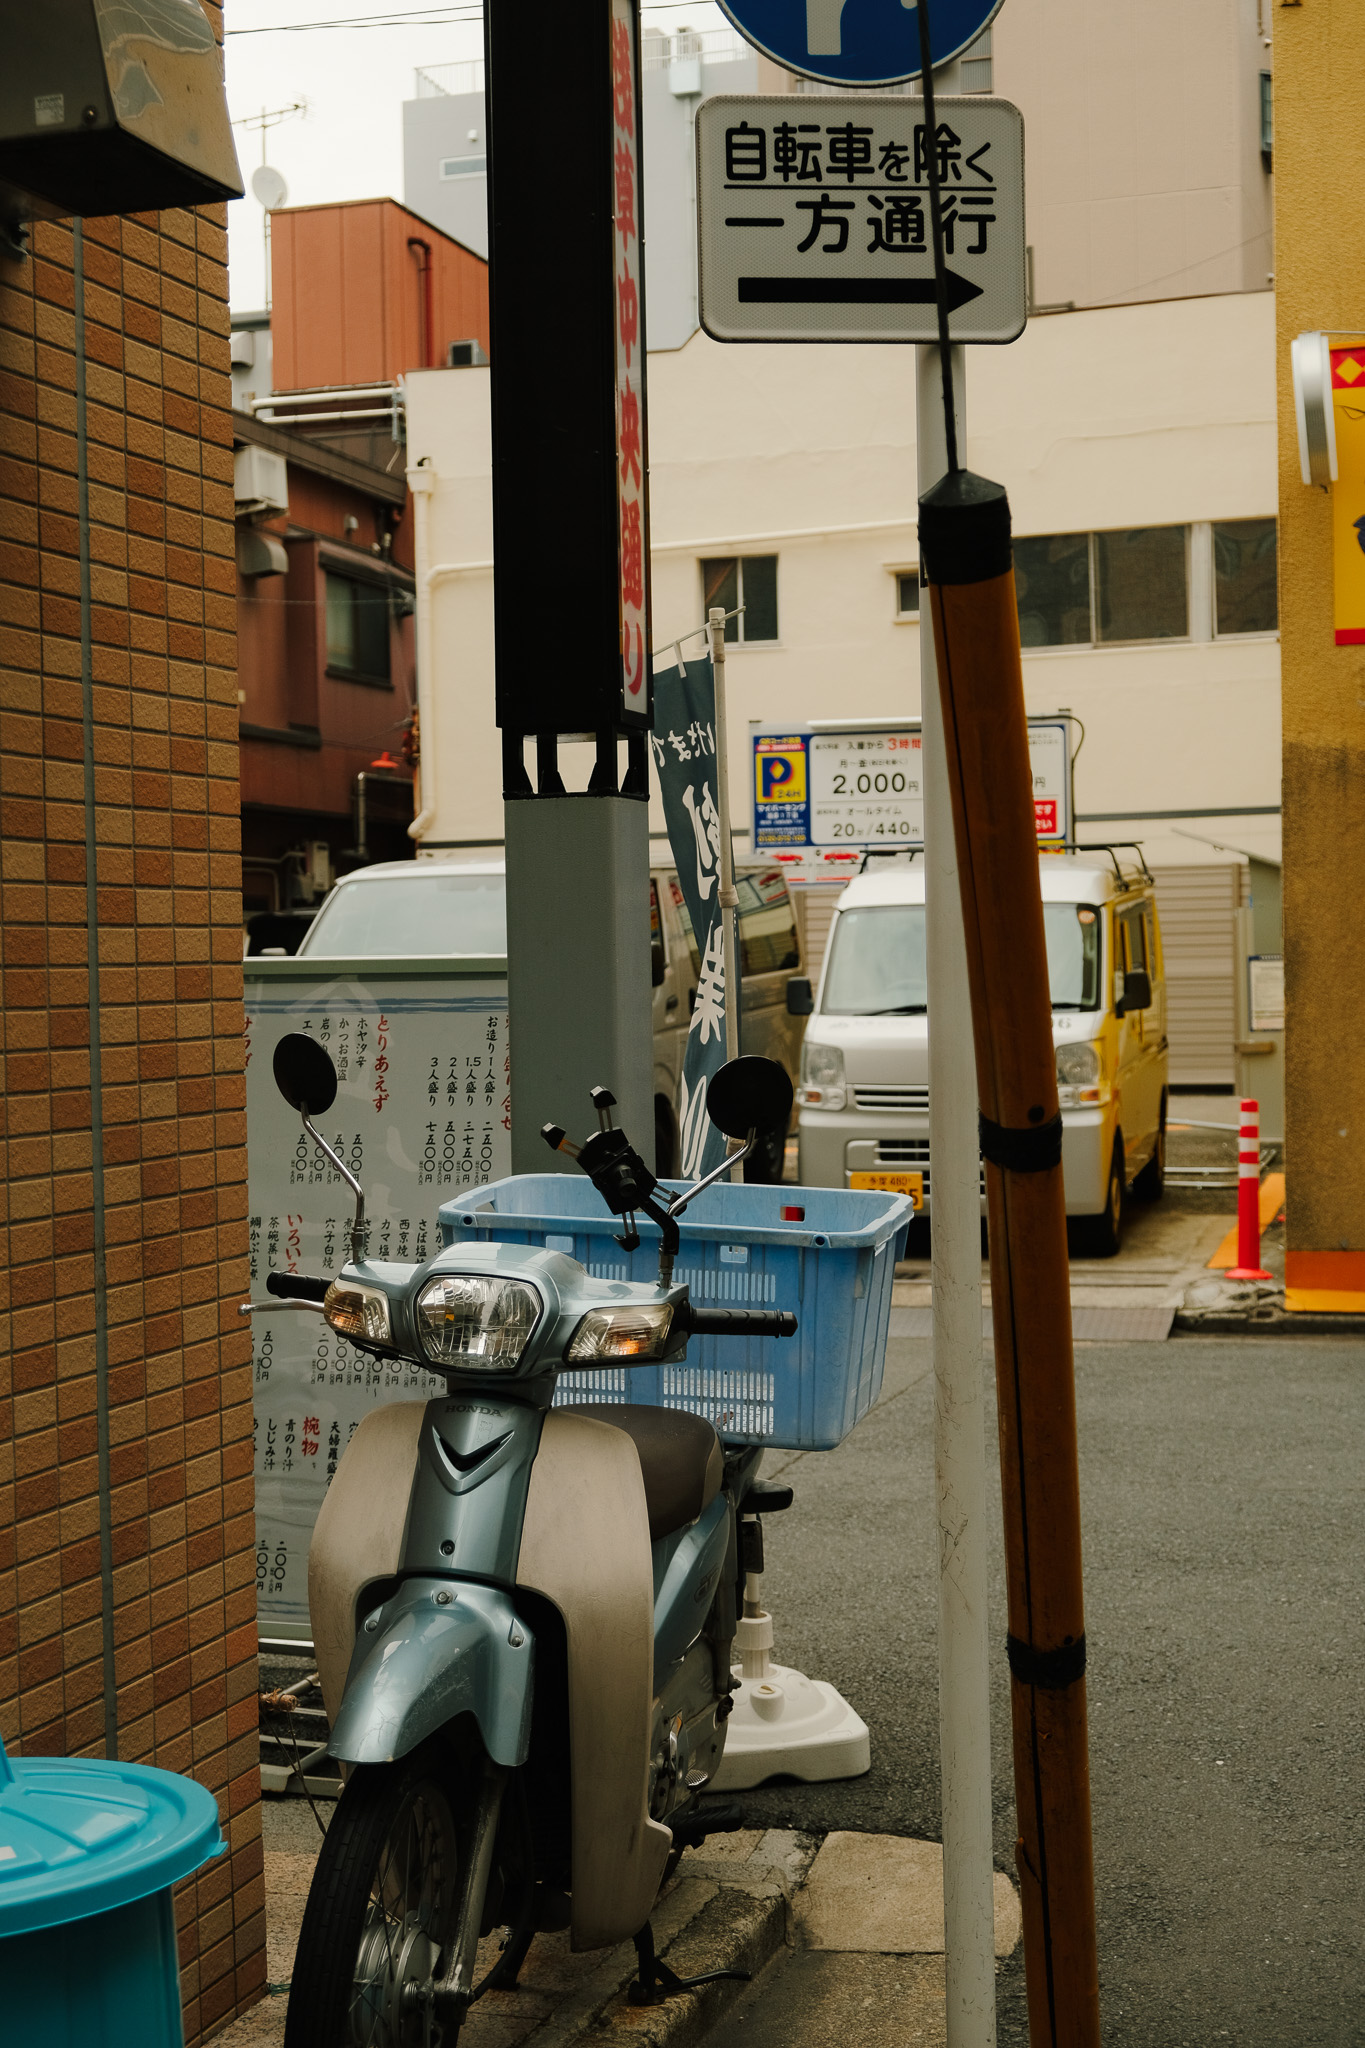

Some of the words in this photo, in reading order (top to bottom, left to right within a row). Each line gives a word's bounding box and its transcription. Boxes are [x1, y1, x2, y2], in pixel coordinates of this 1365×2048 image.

[725, 121, 994, 183] 自転車を除く
[725, 193, 996, 254] 一方通行
[833, 773, 919, 796] 2,000円
[337, 1017, 349, 1081] かつお酒盗
[372, 1014, 390, 1113] とりあえず
[428, 1056, 440, 1106] 3人盛り
[446, 1056, 458, 1106] 2人盛り
[465, 1056, 481, 1106] 1.5人盛り
[296, 1134, 308, 1182] 五〇〇円
[424, 1121, 437, 1183] 七五〇〇円
[443, 1121, 456, 1183] 五〇〇〇円
[462, 1121, 474, 1183] 三七五〇円
[480, 1121, 493, 1183] 二五〇〇円
[267, 1216, 279, 1268] 茶碗蒸し
[285, 1214, 303, 1274] いろいろ
[322, 1218, 336, 1270] 穴子白焼
[396, 1218, 410, 1257] 西京焼
[261, 1331, 273, 1381] 五〇〇円
[301, 1416, 320, 1457] 椀物
[445, 1405, 503, 1418] HONDA
[264, 1418, 277, 1471] しじみ汁
[282, 1419, 296, 1471] 青のり汁
[256, 1540, 269, 1590] 三〇〇円
[274, 1541, 287, 1592] 二〇〇円
